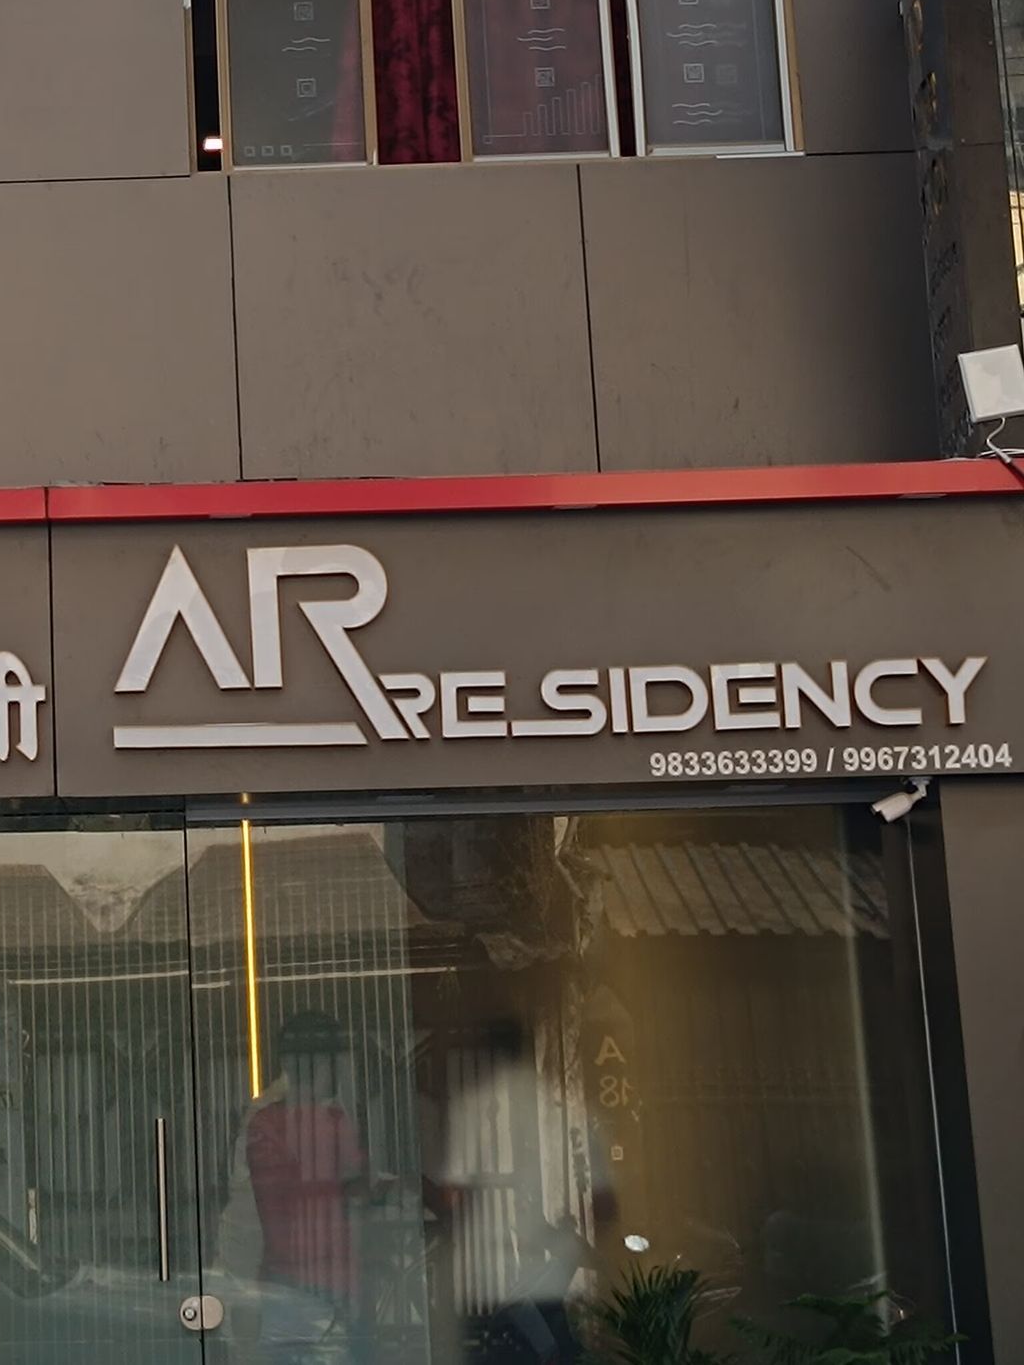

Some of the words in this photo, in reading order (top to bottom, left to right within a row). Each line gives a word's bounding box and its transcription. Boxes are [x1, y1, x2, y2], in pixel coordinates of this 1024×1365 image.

[114, 544, 388, 742] AR
[378, 656, 988, 740] RESIDENCY
[649, 748, 819, 777] 9833633399
[842, 742, 1013, 772] 9967312404
